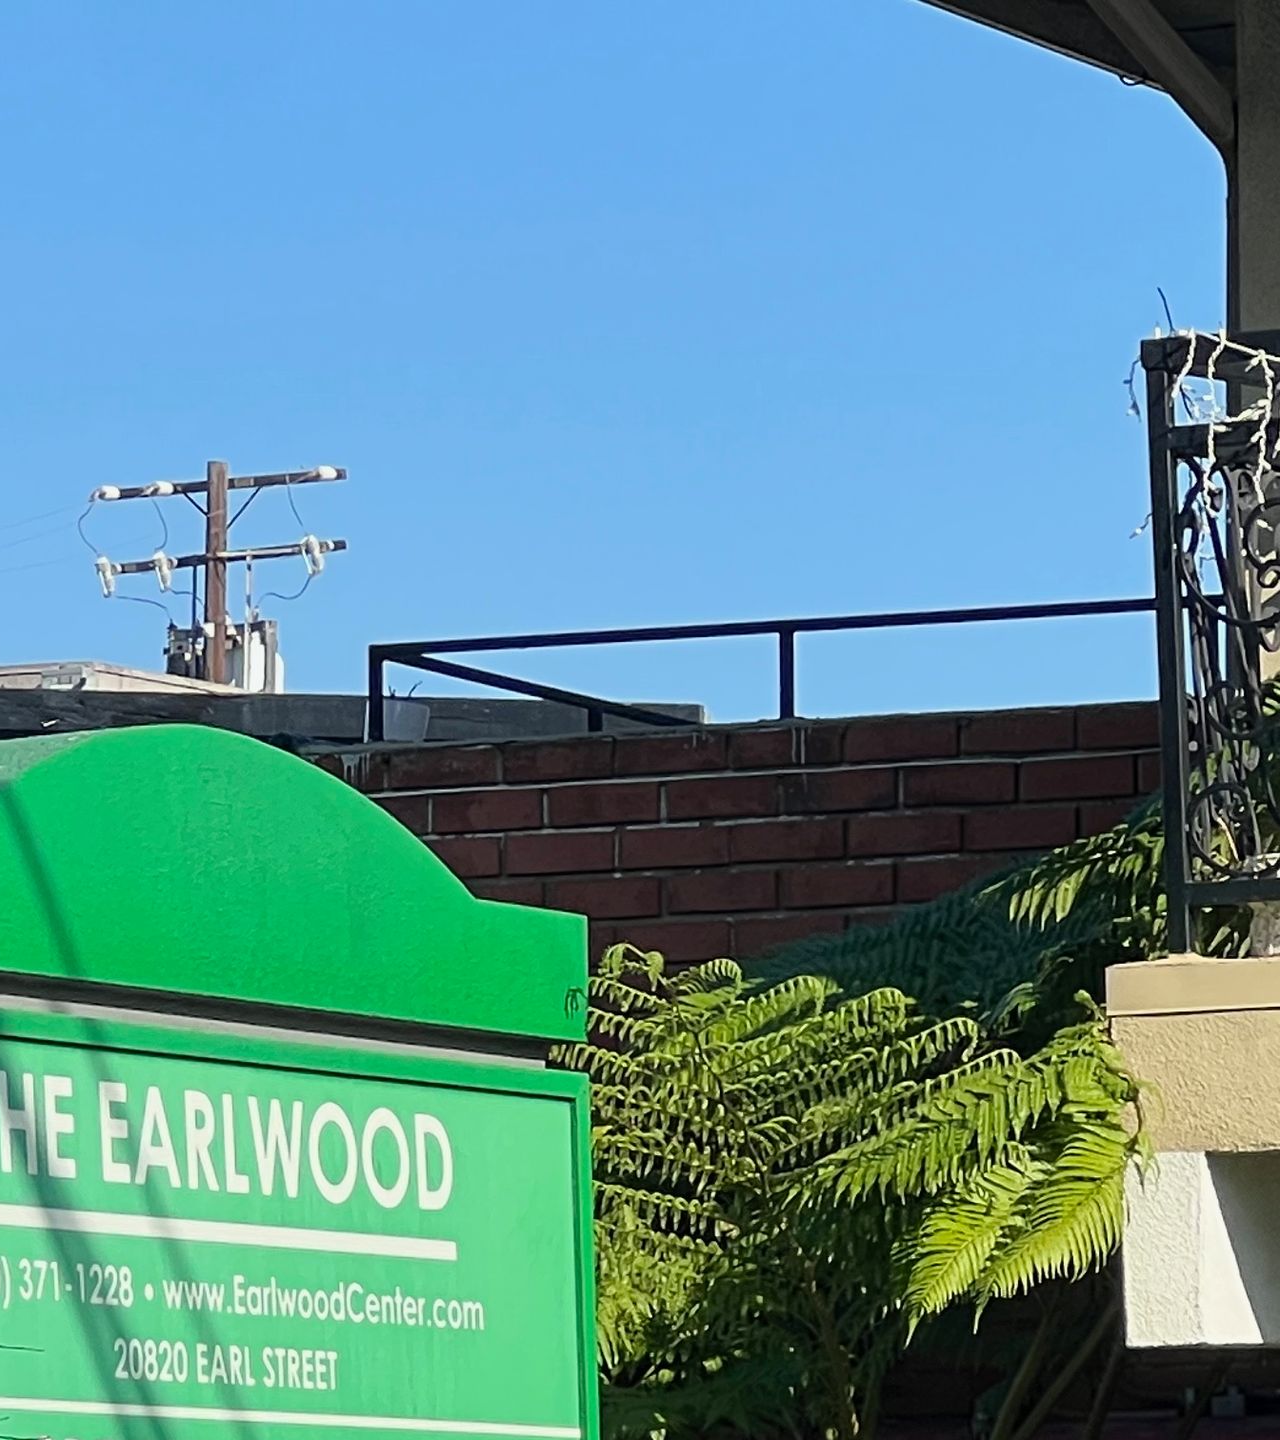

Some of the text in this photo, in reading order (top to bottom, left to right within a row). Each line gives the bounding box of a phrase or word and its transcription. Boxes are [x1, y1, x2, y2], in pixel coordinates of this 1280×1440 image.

[99, 1080, 454, 1211] EARLWOOD
[18, 1256, 135, 1307] 371-1228
[162, 1274, 485, 1331] www.EarlwoodCenter.com
[113, 1338, 338, 1391] 20820 EARL STREET
